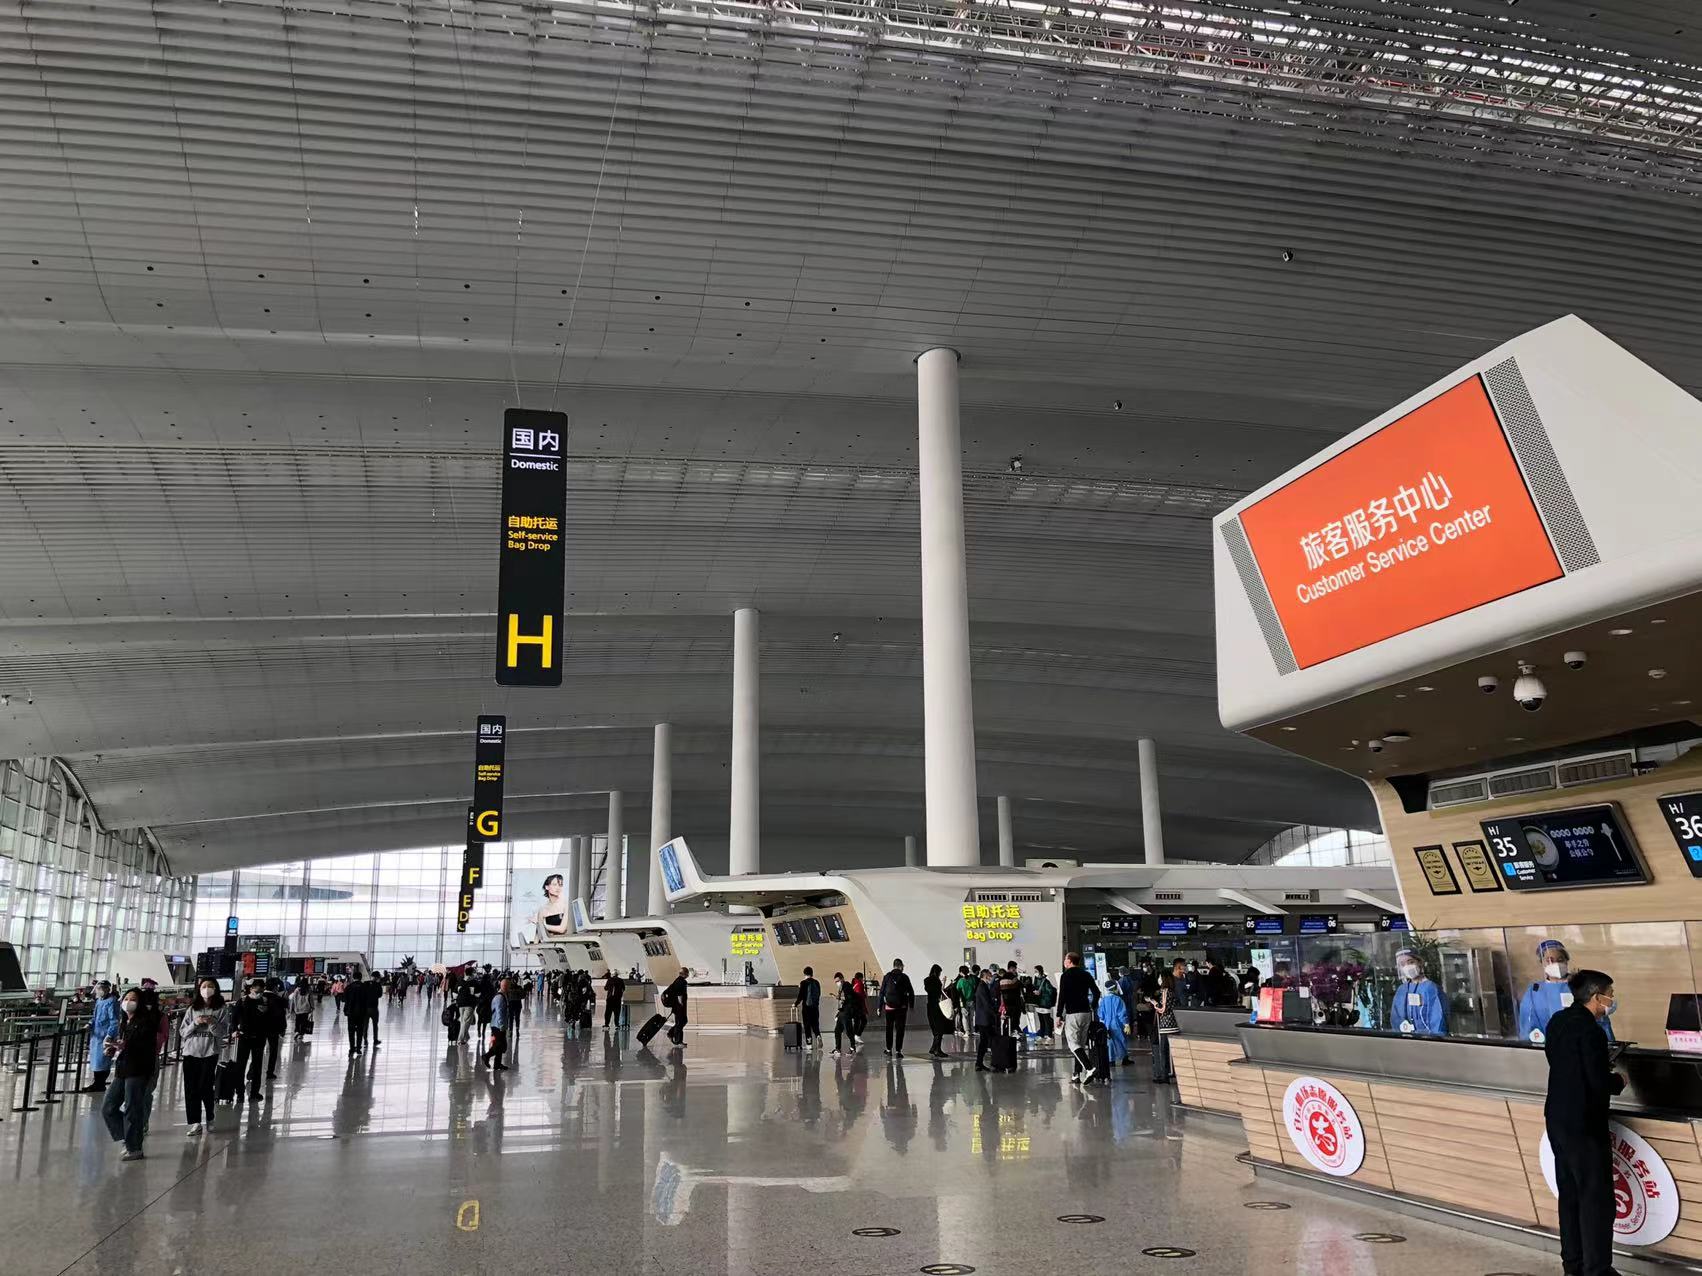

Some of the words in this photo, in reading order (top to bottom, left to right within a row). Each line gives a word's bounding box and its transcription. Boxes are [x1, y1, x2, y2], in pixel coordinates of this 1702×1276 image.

[511, 427, 560, 451] 国内
[511, 459, 559, 471] Domestic
[507, 515, 559, 530] 自助托运
[1299, 471, 1453, 571] 旅客服务中心
[507, 530, 559, 542] Self-service
[507, 540, 527, 551] Bag
[527, 541, 551, 552] Drop
[1296, 561, 1367, 604] Customer
[1366, 531, 1430, 574] Service
[1429, 504, 1492, 545] Center
[506, 613, 554, 669] H
[480, 723, 503, 735] 国内
[476, 810, 499, 836] G
[1675, 815, 1702, 840] 36
[1492, 836, 1518, 858] 35
[468, 867, 480, 885] F
[463, 894, 472, 908] E
[459, 910, 469, 922] D
[962, 904, 1021, 920] 自助托运
[965, 918, 1020, 930] Self-service
[1101, 921, 1111, 929] 03
[1187, 921, 1197, 929] 04
[1246, 920, 1255, 928] 05
[1327, 919, 1336, 928] 06
[1381, 919, 1391, 927] 07
[966, 930, 987, 942] Bag
[988, 930, 1014, 942] Drop
